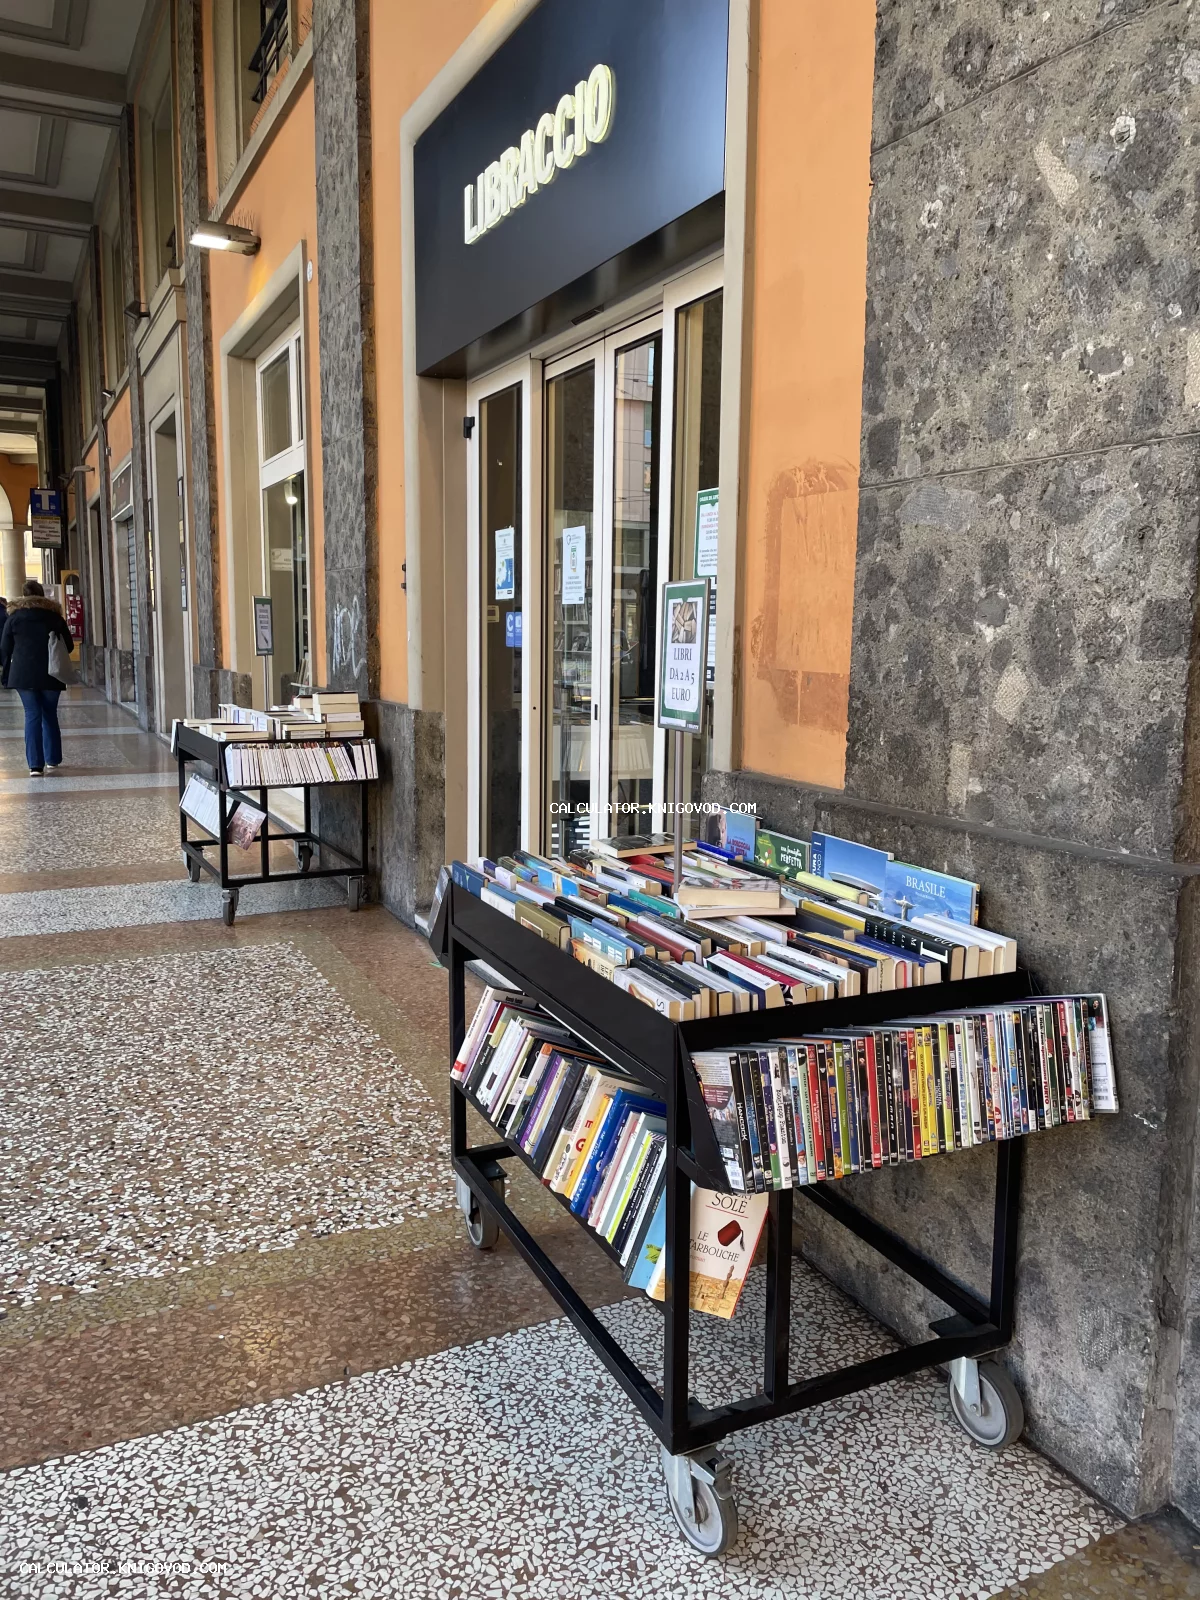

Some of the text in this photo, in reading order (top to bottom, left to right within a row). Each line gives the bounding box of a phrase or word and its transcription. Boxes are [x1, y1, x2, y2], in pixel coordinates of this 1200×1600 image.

[464, 64, 614, 244] LIBRACCIO
[674, 648, 692, 661] LIBRI
[669, 668, 695, 685] DA 2 A 5
[671, 688, 690, 701] EURO
[780, 853, 802, 869] PERFETTA
[905, 875, 946, 898] BRASILE
[829, 1087, 837, 1118] GARFIELD
[737, 1102, 748, 1141] HANCOCK
[779, 1120, 787, 1144] Phantom
[697, 1231, 709, 1242] LE
[690, 1239, 740, 1262] TARBOUCHE
